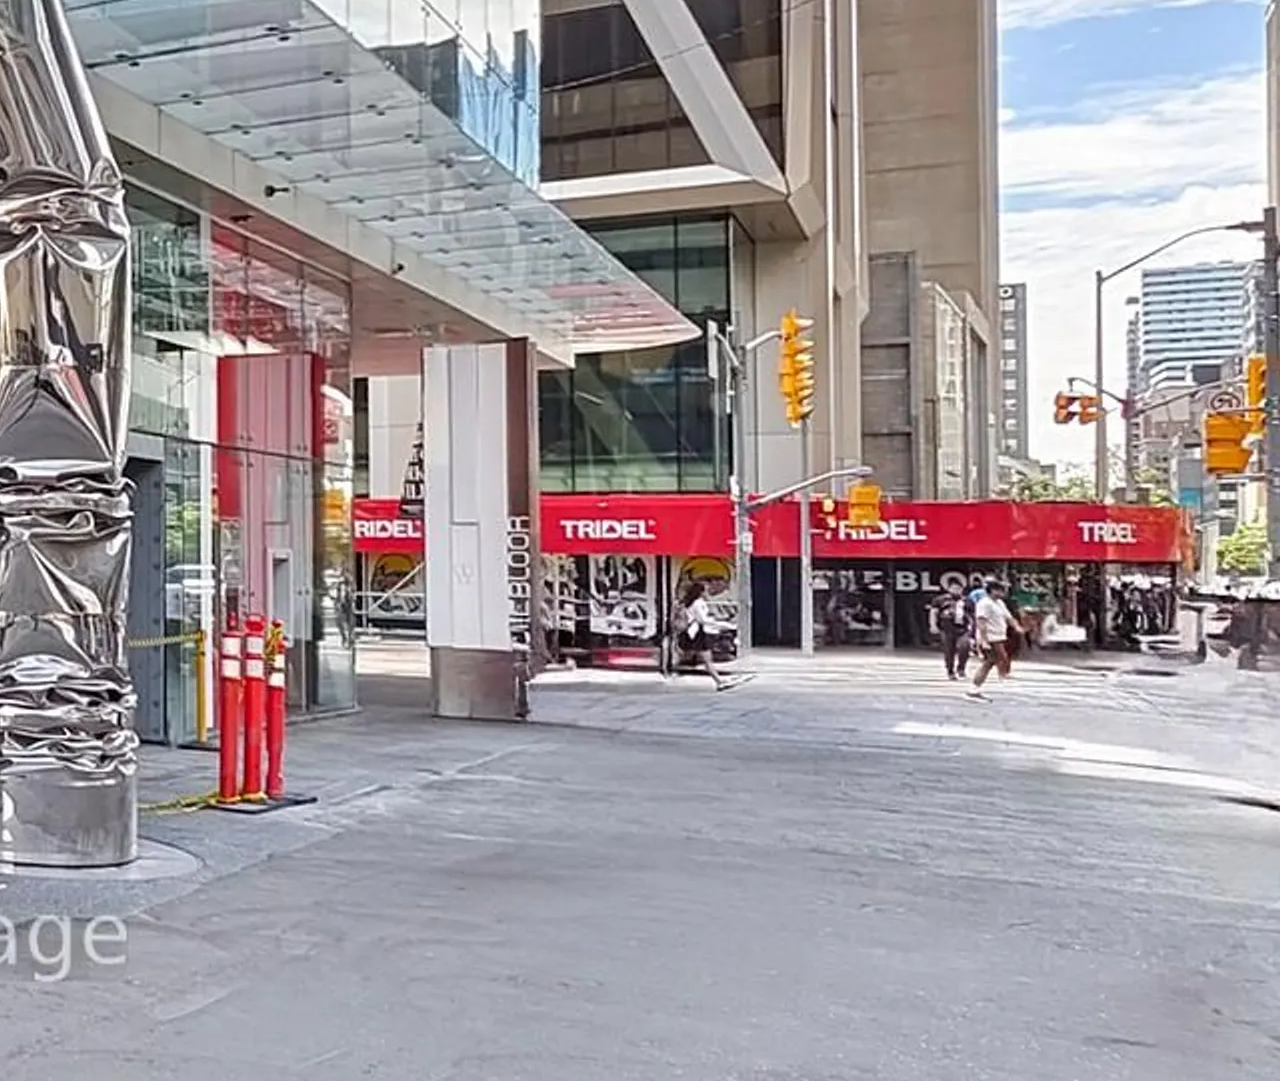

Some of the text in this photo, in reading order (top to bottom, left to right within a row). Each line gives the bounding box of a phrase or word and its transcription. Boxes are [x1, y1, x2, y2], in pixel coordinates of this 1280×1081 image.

[354, 520, 422, 539] RIDEL
[560, 519, 656, 540] TRIDEL
[826, 518, 928, 540] RIDEL
